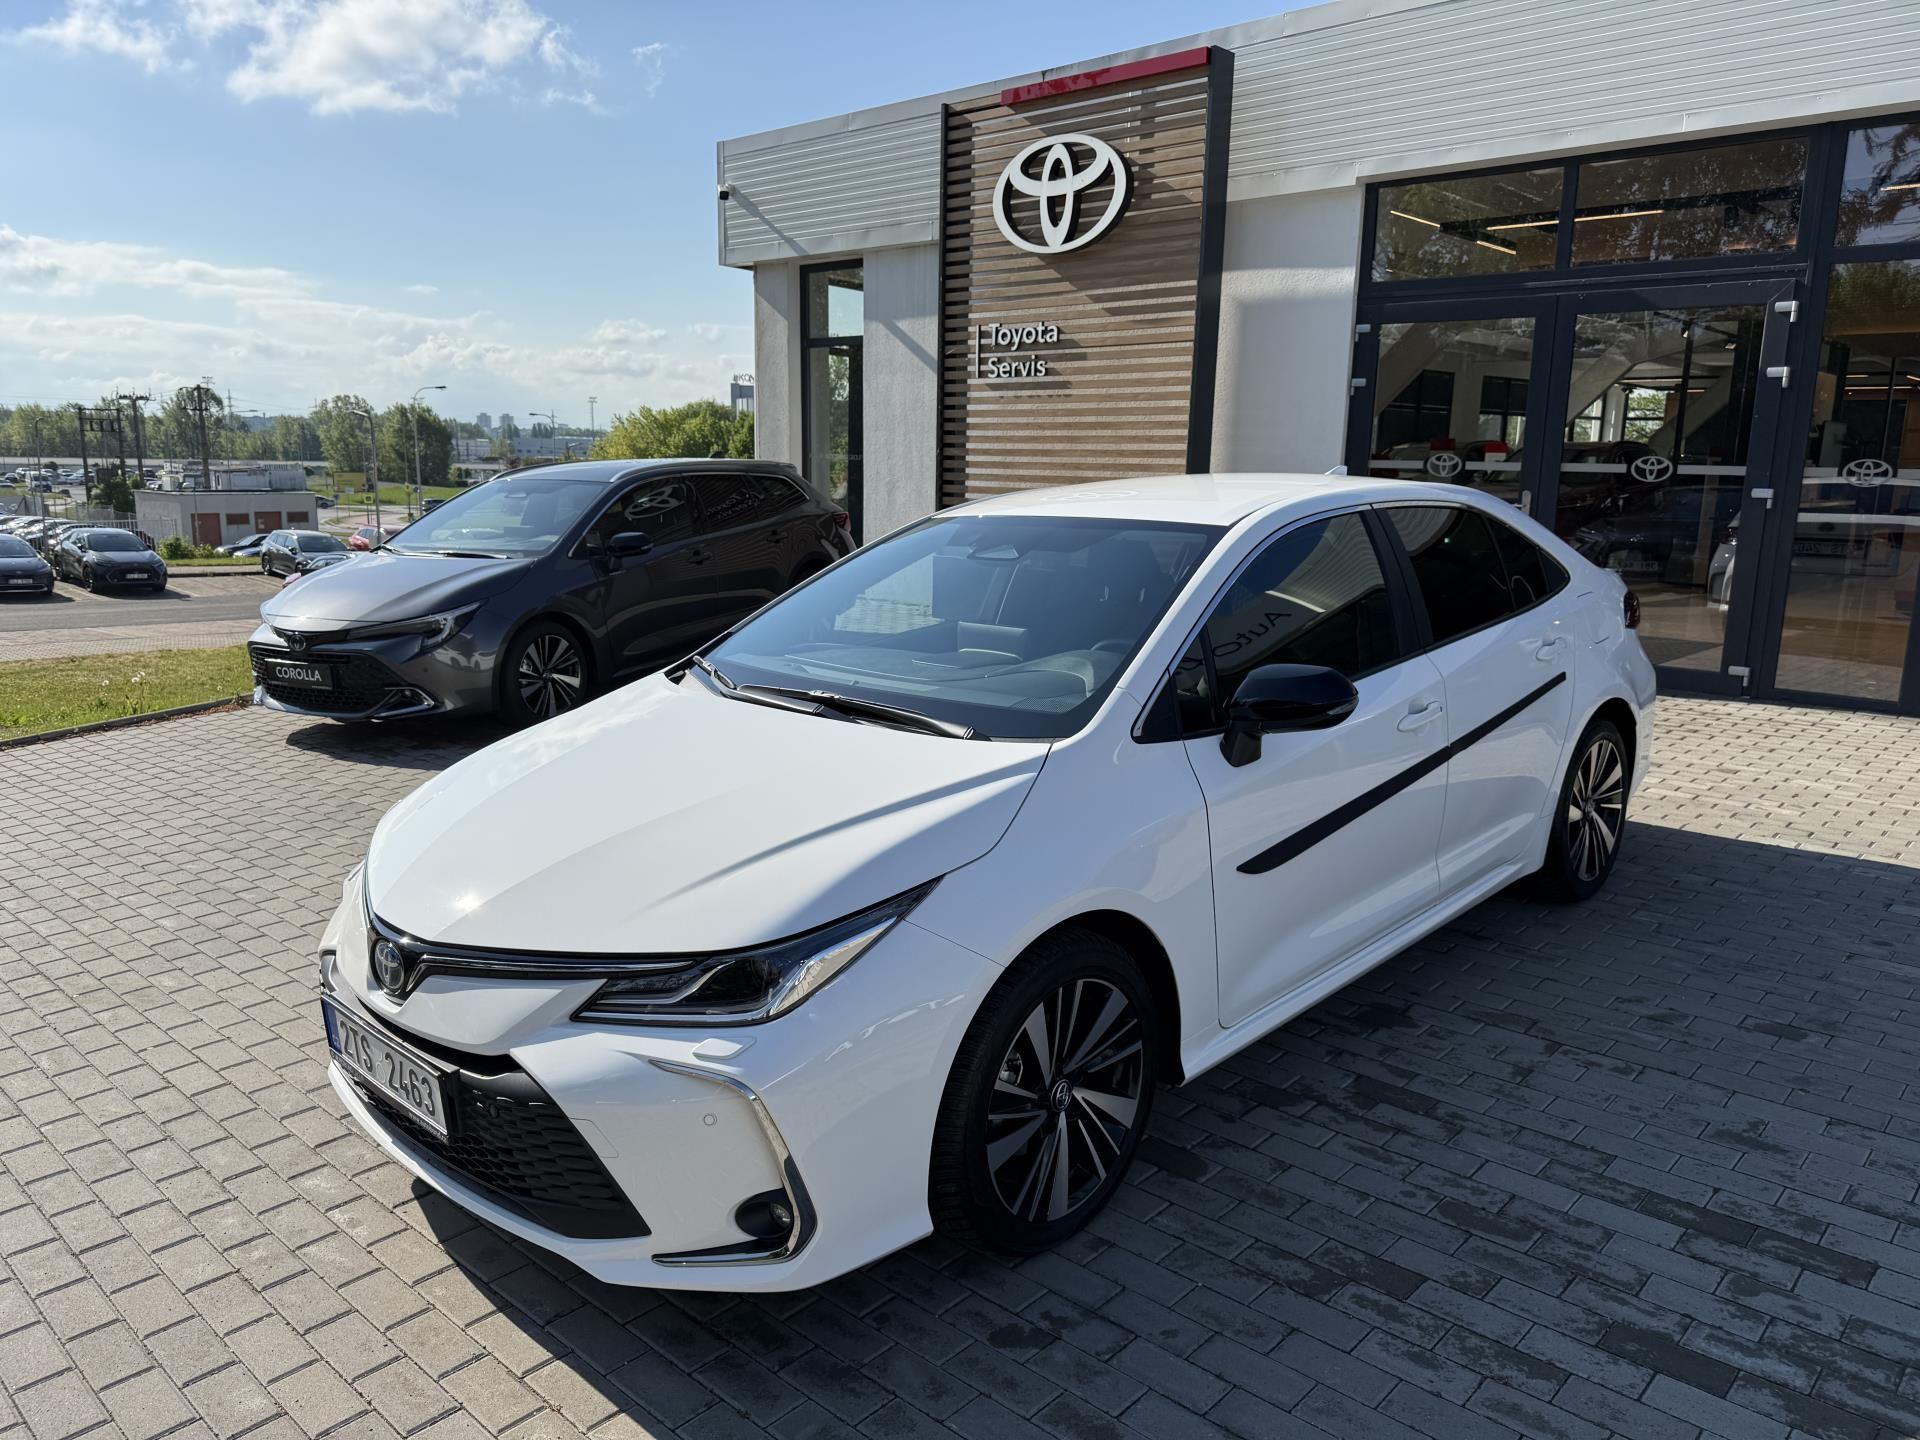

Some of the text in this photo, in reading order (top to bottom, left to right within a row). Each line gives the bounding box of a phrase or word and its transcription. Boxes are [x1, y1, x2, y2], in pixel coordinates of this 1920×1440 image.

[989, 321, 1059, 350] Toyota
[988, 355, 1046, 378] Servis
[276, 666, 323, 682] COROLLA
[340, 1020, 373, 1072] 2TS
[385, 1052, 436, 1116] 2463
